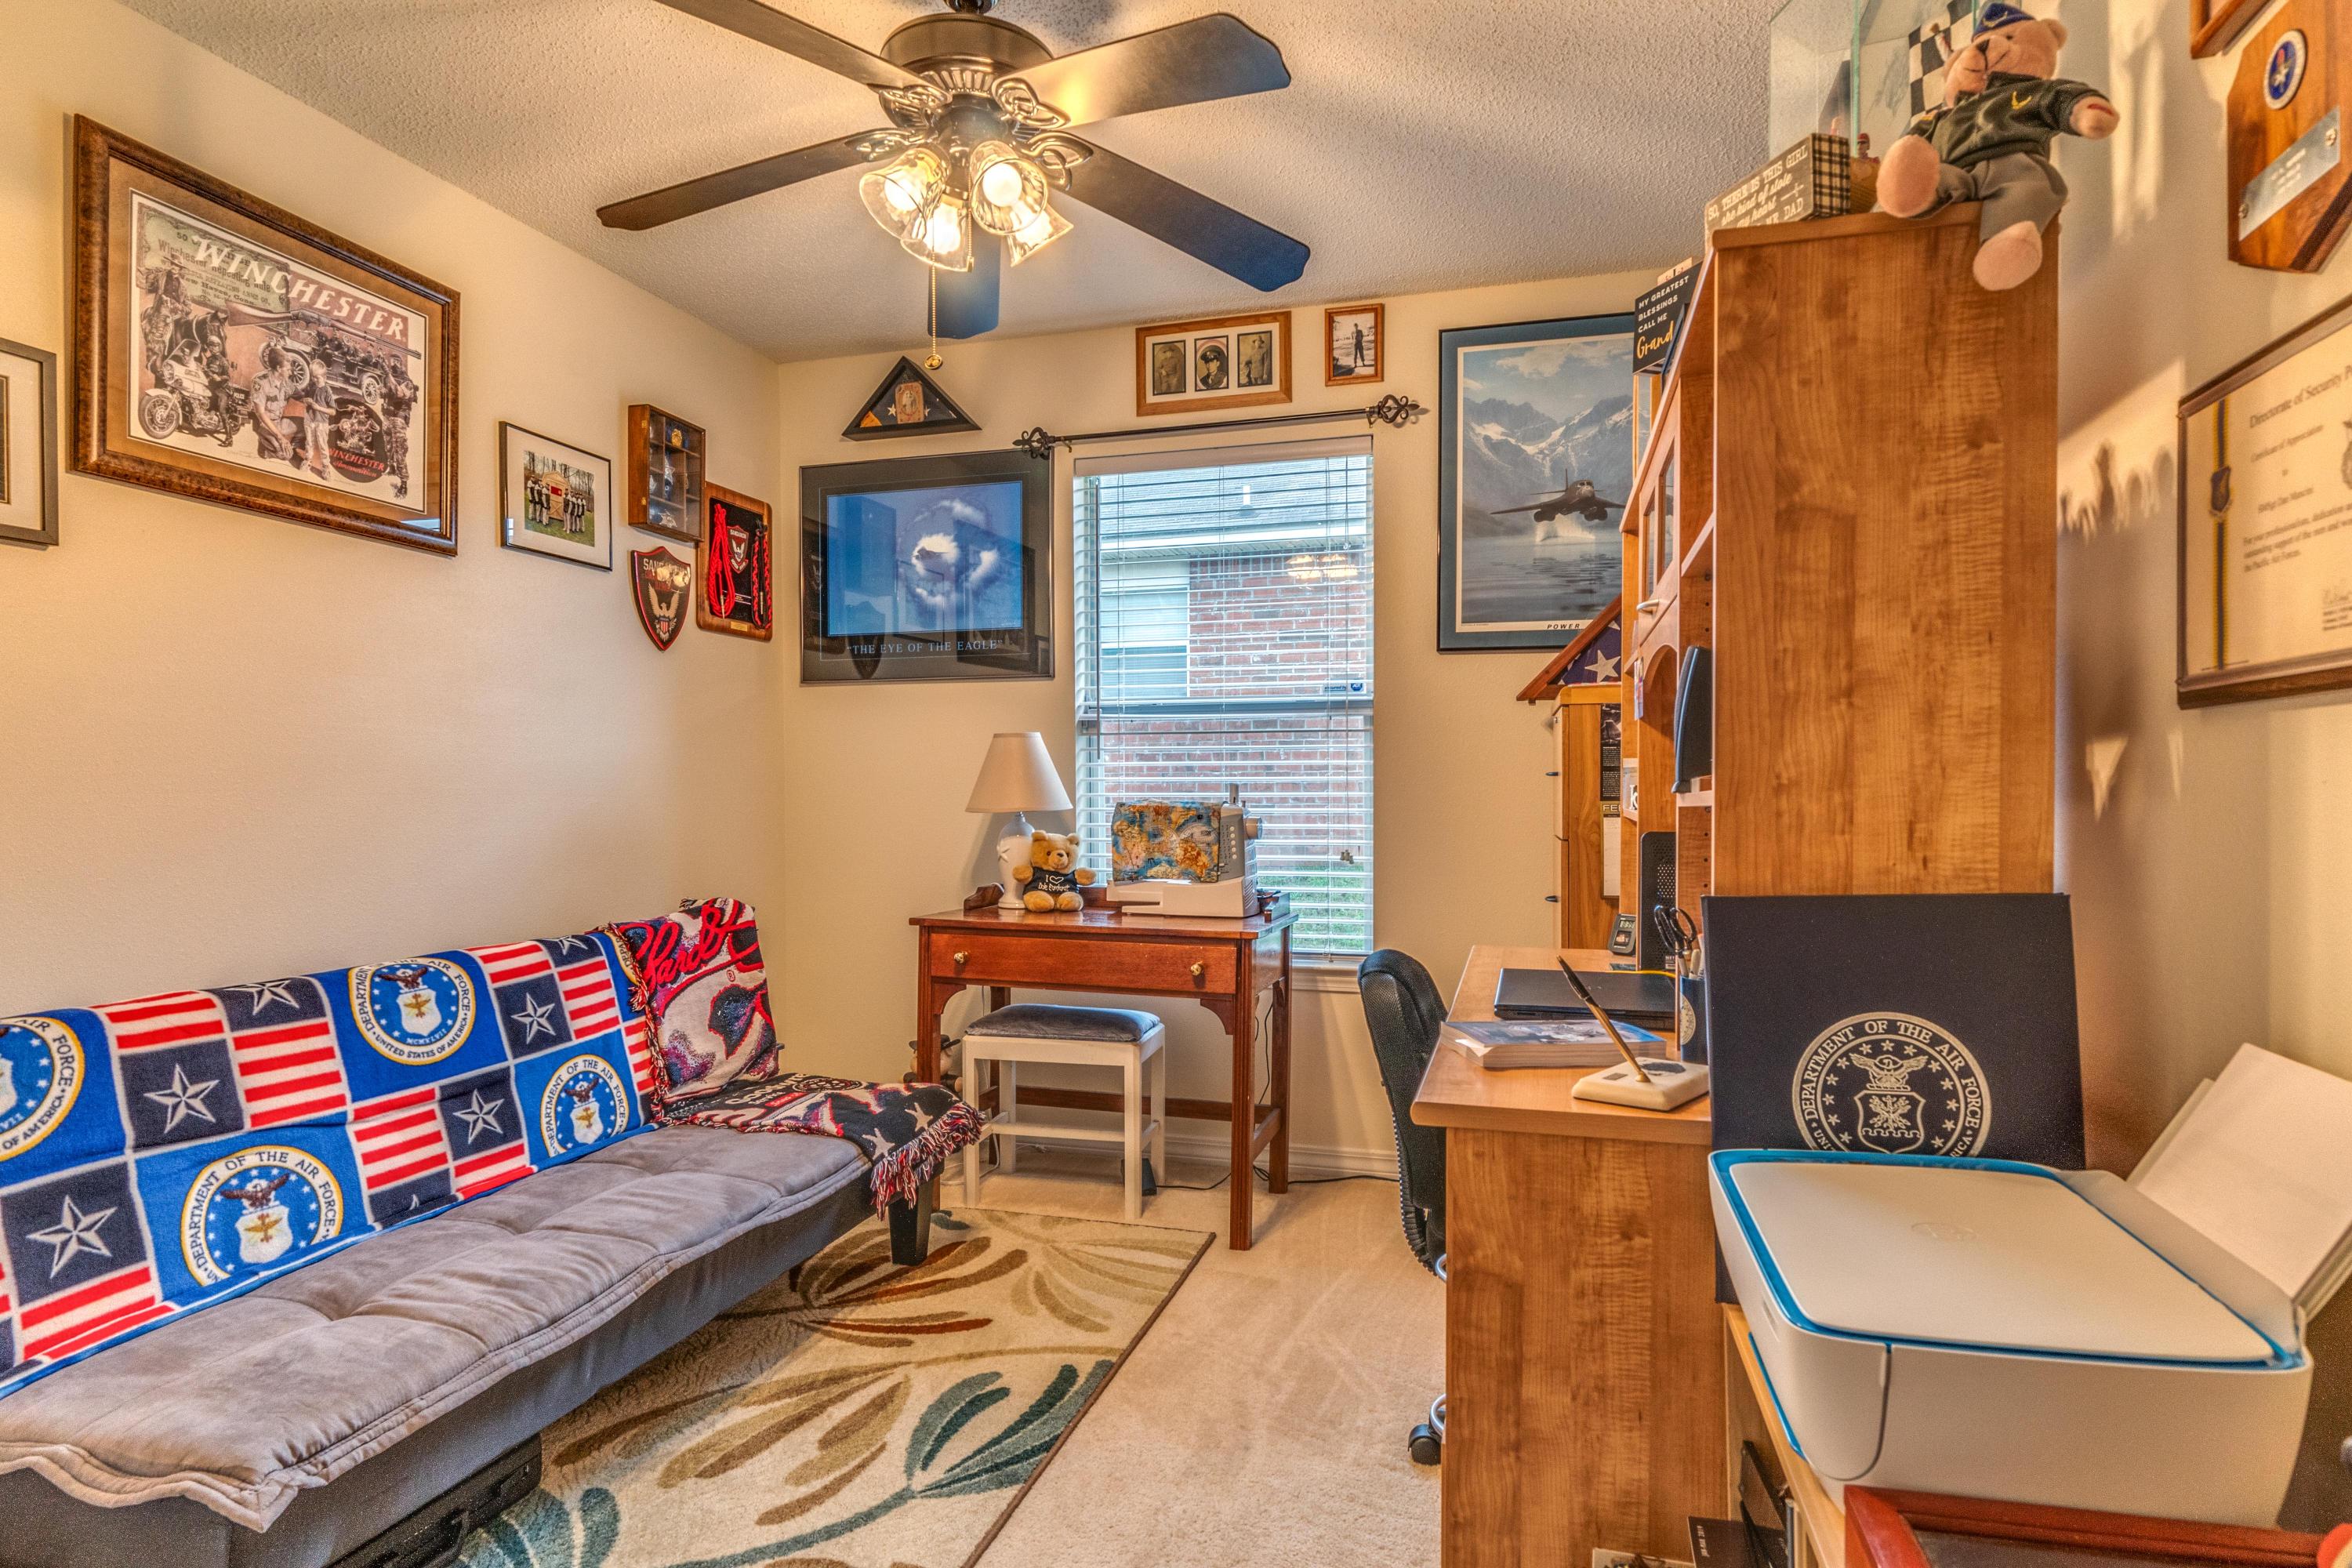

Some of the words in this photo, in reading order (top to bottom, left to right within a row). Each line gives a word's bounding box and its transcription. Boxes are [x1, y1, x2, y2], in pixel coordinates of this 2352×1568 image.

[1762, 160, 1784, 184] THIS
[1785, 144, 1809, 169] GIRL
[1737, 193, 1757, 216] kind
[1757, 183, 1769, 205] of
[1769, 172, 1793, 196] stole
[1784, 197, 1804, 221] DAD
[191, 234, 405, 340] WINCHESTER
[1638, 294, 1679, 321] BLESSINGS
[1639, 297, 1650, 310] MY
[1650, 275, 1690, 303] GREATEST
[1638, 321, 1656, 333] CALL
[1657, 312, 1668, 323] ME
[880, 643, 903, 653] EYE
[907, 643, 923, 653] OF
[927, 641, 952, 652] THE
[427, 960, 452, 972] AIR
[453, 974, 471, 1013] FORCE
[13, 1018, 51, 1033] AIR
[52, 1033, 76, 1087] FORCE
[375, 1033, 405, 1057] UNITED
[406, 1049, 436, 1059] STATES
[436, 1044, 448, 1054] OF
[447, 1017, 468, 1048] AMERICA
[566, 1062, 579, 1075] OF
[582, 1058, 599, 1070] THE
[601, 1066, 615, 1083] AIR
[612, 1083, 626, 1120] FORCE
[1801, 1026, 1855, 1122] DEPARTMENT
[1864, 1020, 1889, 1034] OF
[1896, 1021, 1933, 1044] THE
[1934, 1043, 1966, 1073] AIR
[1960, 1076, 1983, 1129] FORCE
[2, 1136, 20, 1151] OF
[22, 1091, 65, 1141] AMERICA
[188, 1171, 221, 1270] DEPARTMENT
[224, 1155, 247, 1171] OF
[255, 1150, 290, 1164] THE
[295, 1158, 320, 1180] AIR
[318, 1181, 337, 1228] FORCE
